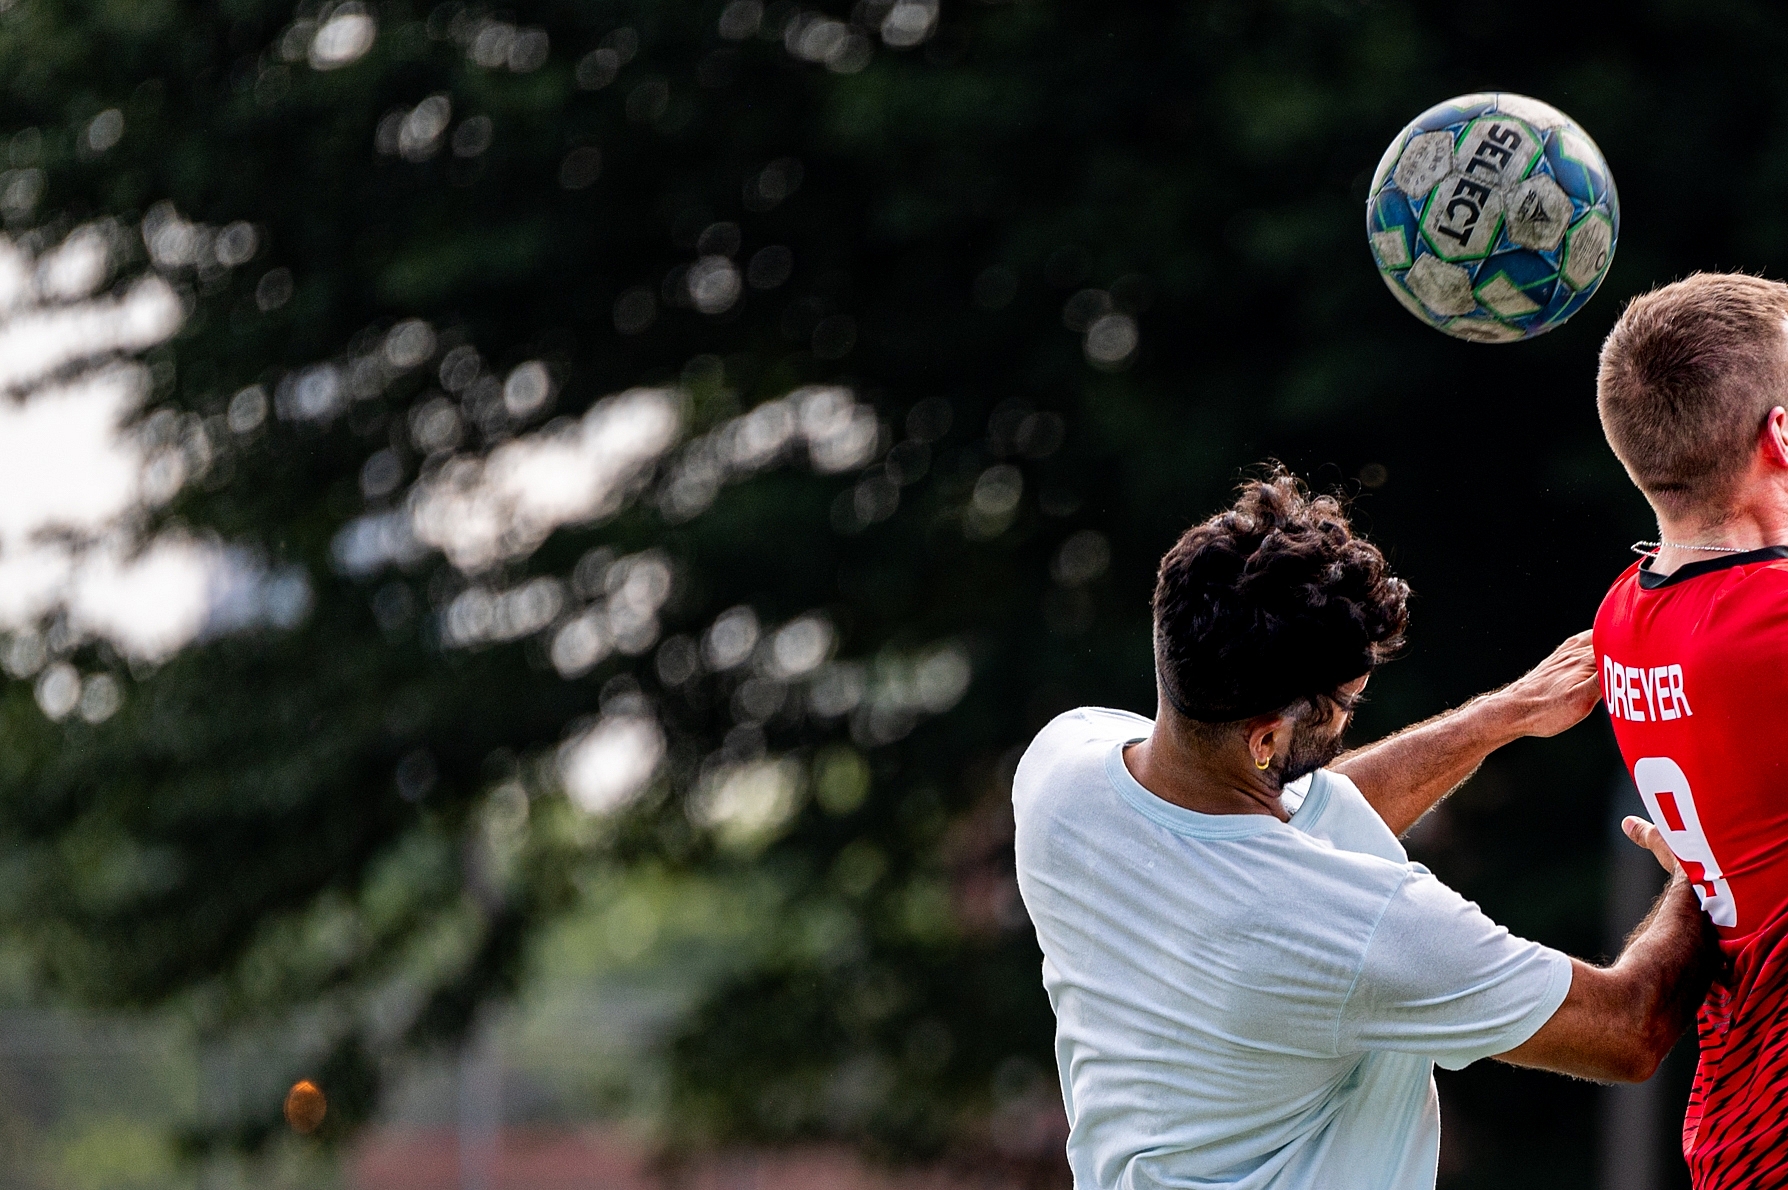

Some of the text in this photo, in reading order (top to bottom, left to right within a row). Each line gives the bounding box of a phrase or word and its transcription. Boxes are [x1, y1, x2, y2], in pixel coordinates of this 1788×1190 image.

[1438, 124, 1522, 246] SELECT
[1604, 654, 1692, 721] DREYER
[1634, 757, 1736, 927] 9
